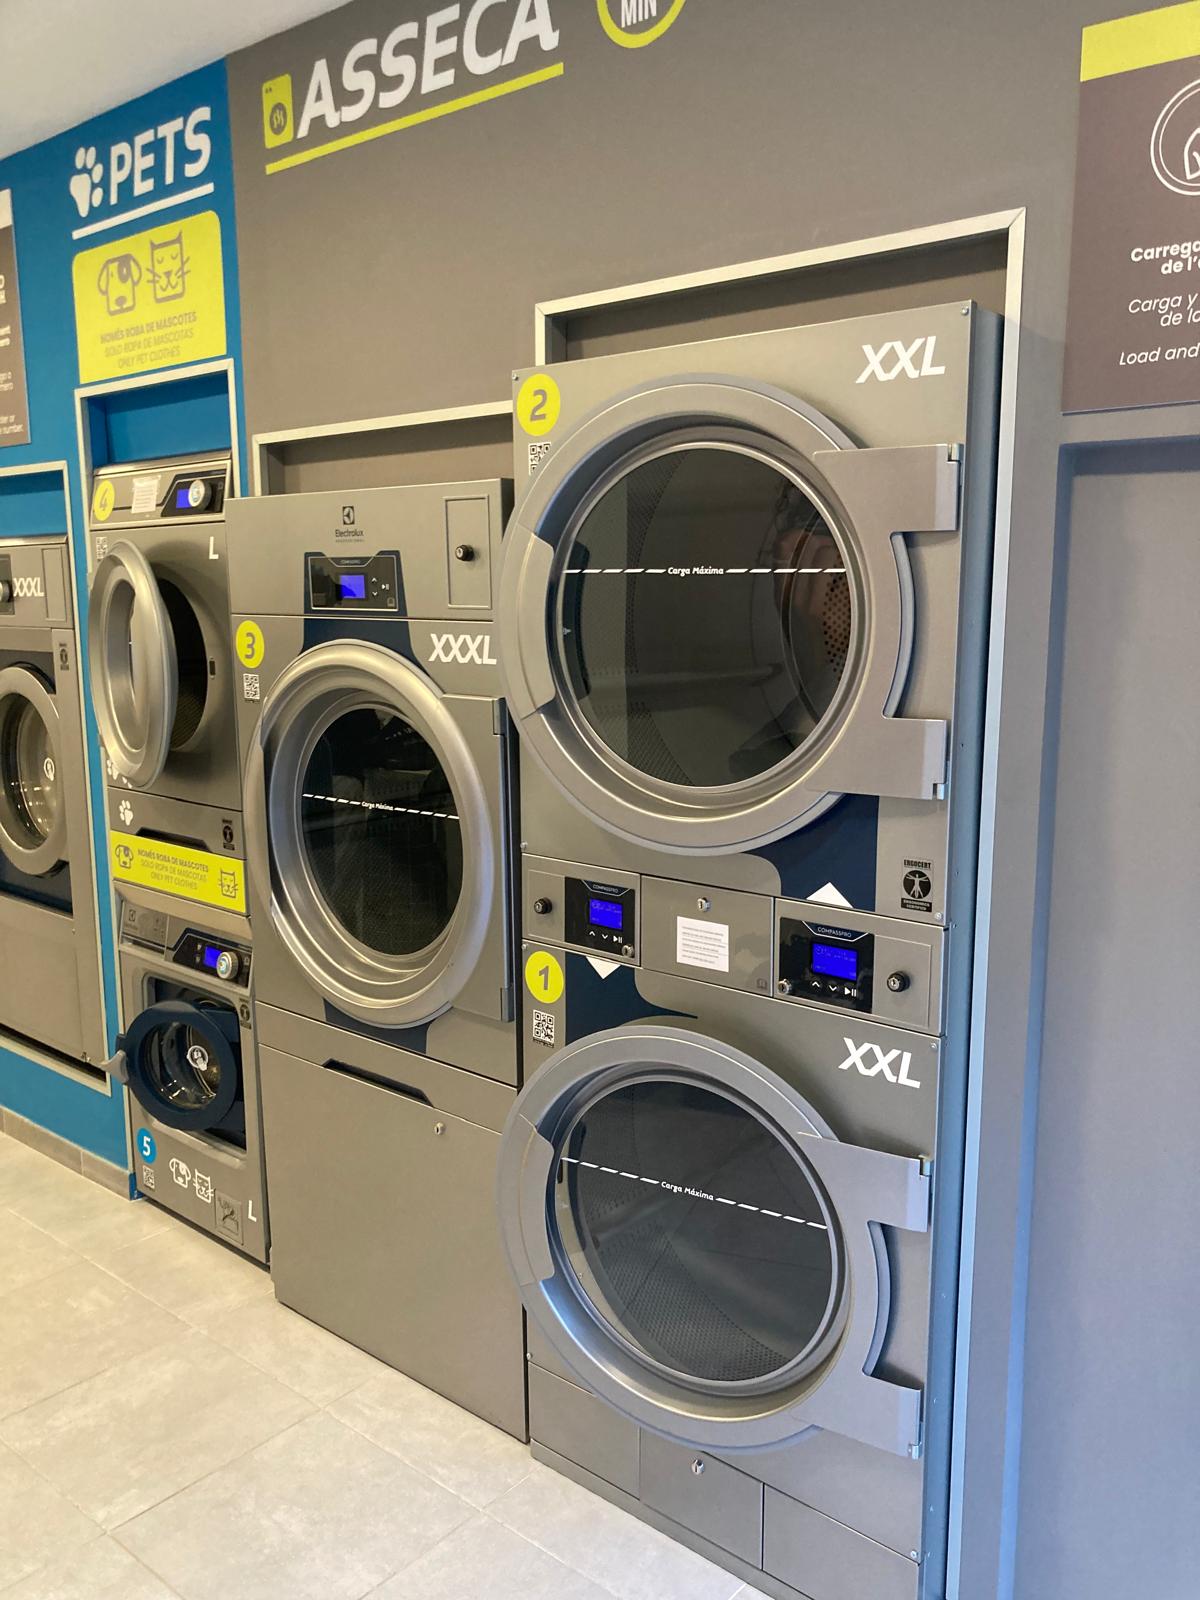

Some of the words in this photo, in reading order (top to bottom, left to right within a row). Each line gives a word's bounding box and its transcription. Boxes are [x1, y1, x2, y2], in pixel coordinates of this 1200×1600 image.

[621, 0, 657, 28] MIN
[297, 0, 560, 139] ASSECA
[109, 107, 212, 205] PETS
[1161, 259, 1184, 274] de
[1128, 295, 1182, 313] Carga
[1187, 293, 1198, 310] y
[145, 322, 155, 333] DE
[155, 311, 197, 331] MASCOTES
[1160, 311, 1183, 327] de
[855, 335, 946, 384] XXL
[1119, 347, 1161, 366] Load
[1165, 342, 1200, 361] and
[530, 389, 547, 421] 2
[99, 489, 108, 511] 4
[335, 529, 364, 537] Electrolux
[208, 536, 219, 560] L
[667, 566, 690, 577] Carga
[692, 565, 724, 575] Máxima
[13, 577, 44, 597] XXXL
[245, 632, 256, 659] 3
[428, 633, 497, 665] XXXL
[361, 801, 375, 810] Carga
[169, 866, 176, 874] DE
[171, 857, 178, 866] DE
[179, 859, 209, 873] MASCOTES
[817, 926, 852, 938] COMPASSPRO
[538, 965, 551, 991] 1
[838, 1037, 921, 1089] XXL
[142, 1135, 151, 1156] 5
[660, 1181, 683, 1193] Carga
[684, 1186, 714, 1201] Máxima
[248, 1200, 257, 1222] L
